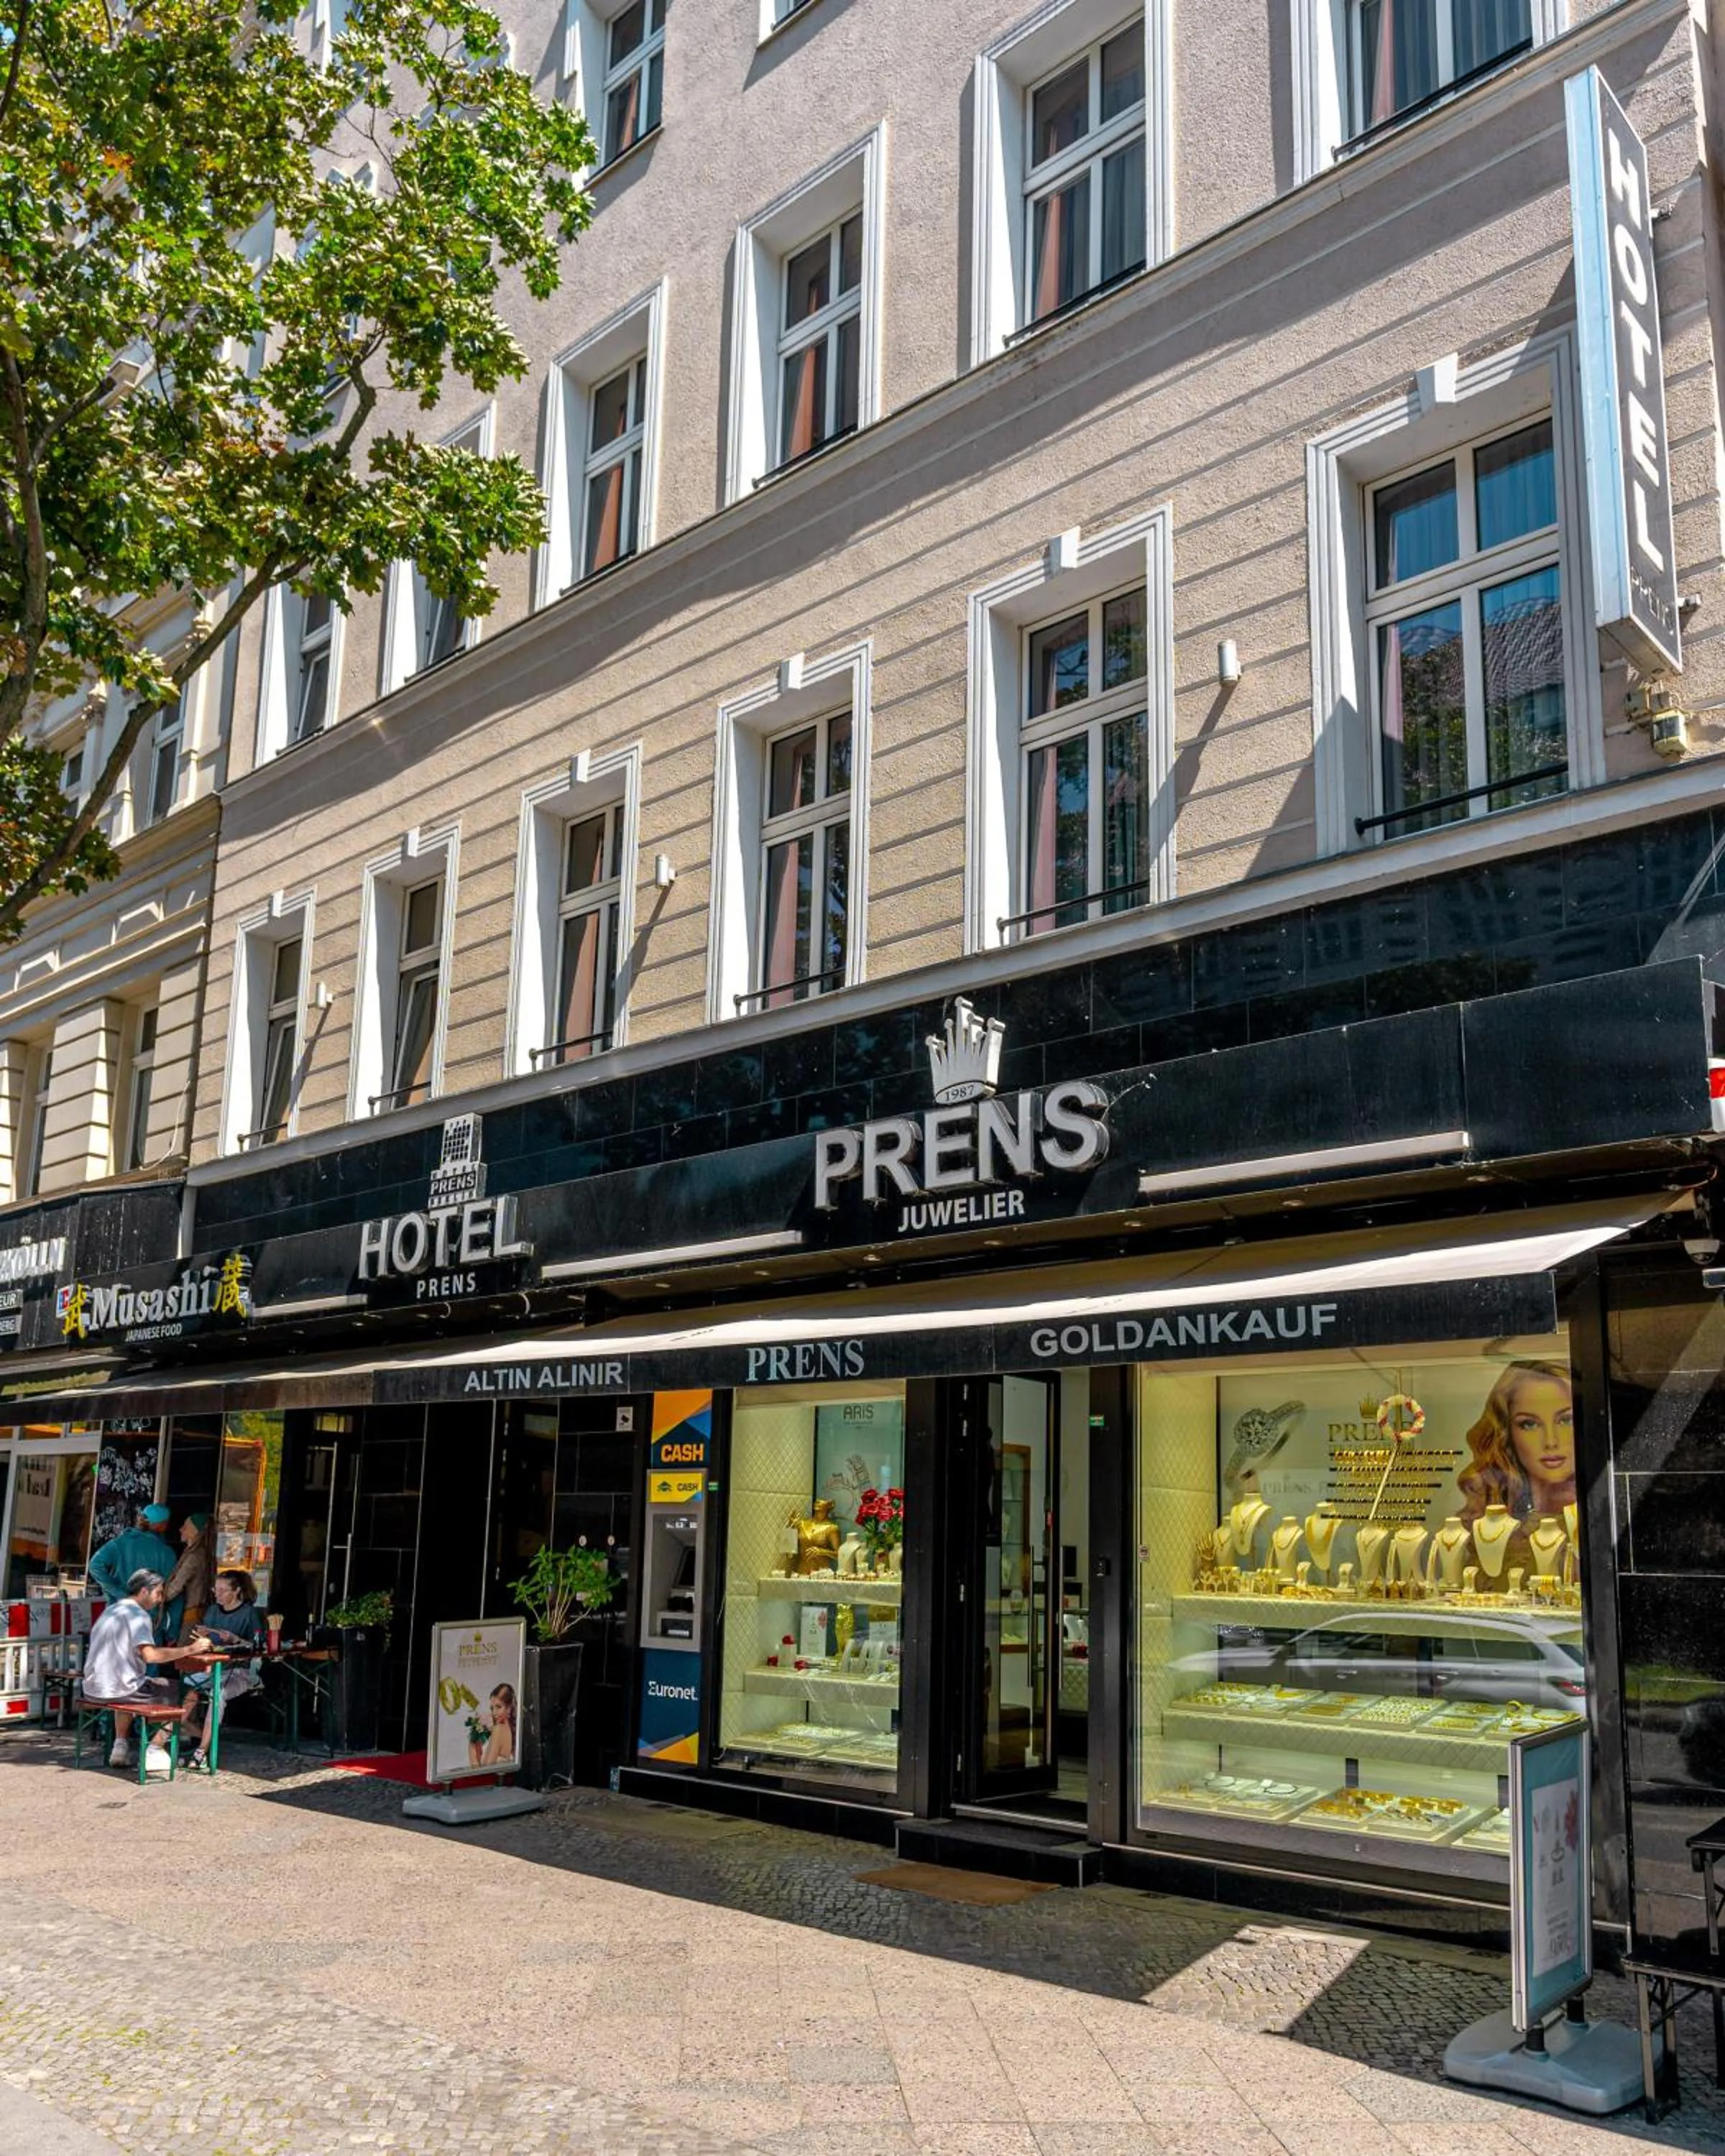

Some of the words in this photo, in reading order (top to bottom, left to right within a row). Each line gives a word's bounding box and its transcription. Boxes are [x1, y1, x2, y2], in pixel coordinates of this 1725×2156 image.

[1609, 128, 1664, 572] HOTEL
[945, 1084, 975, 1102] 1987
[814, 1082, 1110, 1210] PRENS
[431, 1173, 474, 1196] PRENS
[898, 1190, 1024, 1232] JUWELIER
[359, 1196, 533, 1279] HOTEL
[89, 1266, 212, 1330] Musashi
[416, 1272, 476, 1299] PRENS
[125, 1327, 160, 1343] JAPANESE
[160, 1323, 183, 1338] FOOD
[1030, 1303, 1338, 1357] GOLDANKAUF
[746, 1340, 865, 1382] PRENS
[464, 1368, 530, 1392] ALTIN
[537, 1362, 623, 1388] ALINIR
[1328, 1421, 1414, 1442] PRE
[661, 1444, 704, 1462] CASH
[676, 1483, 699, 1492] CASH
